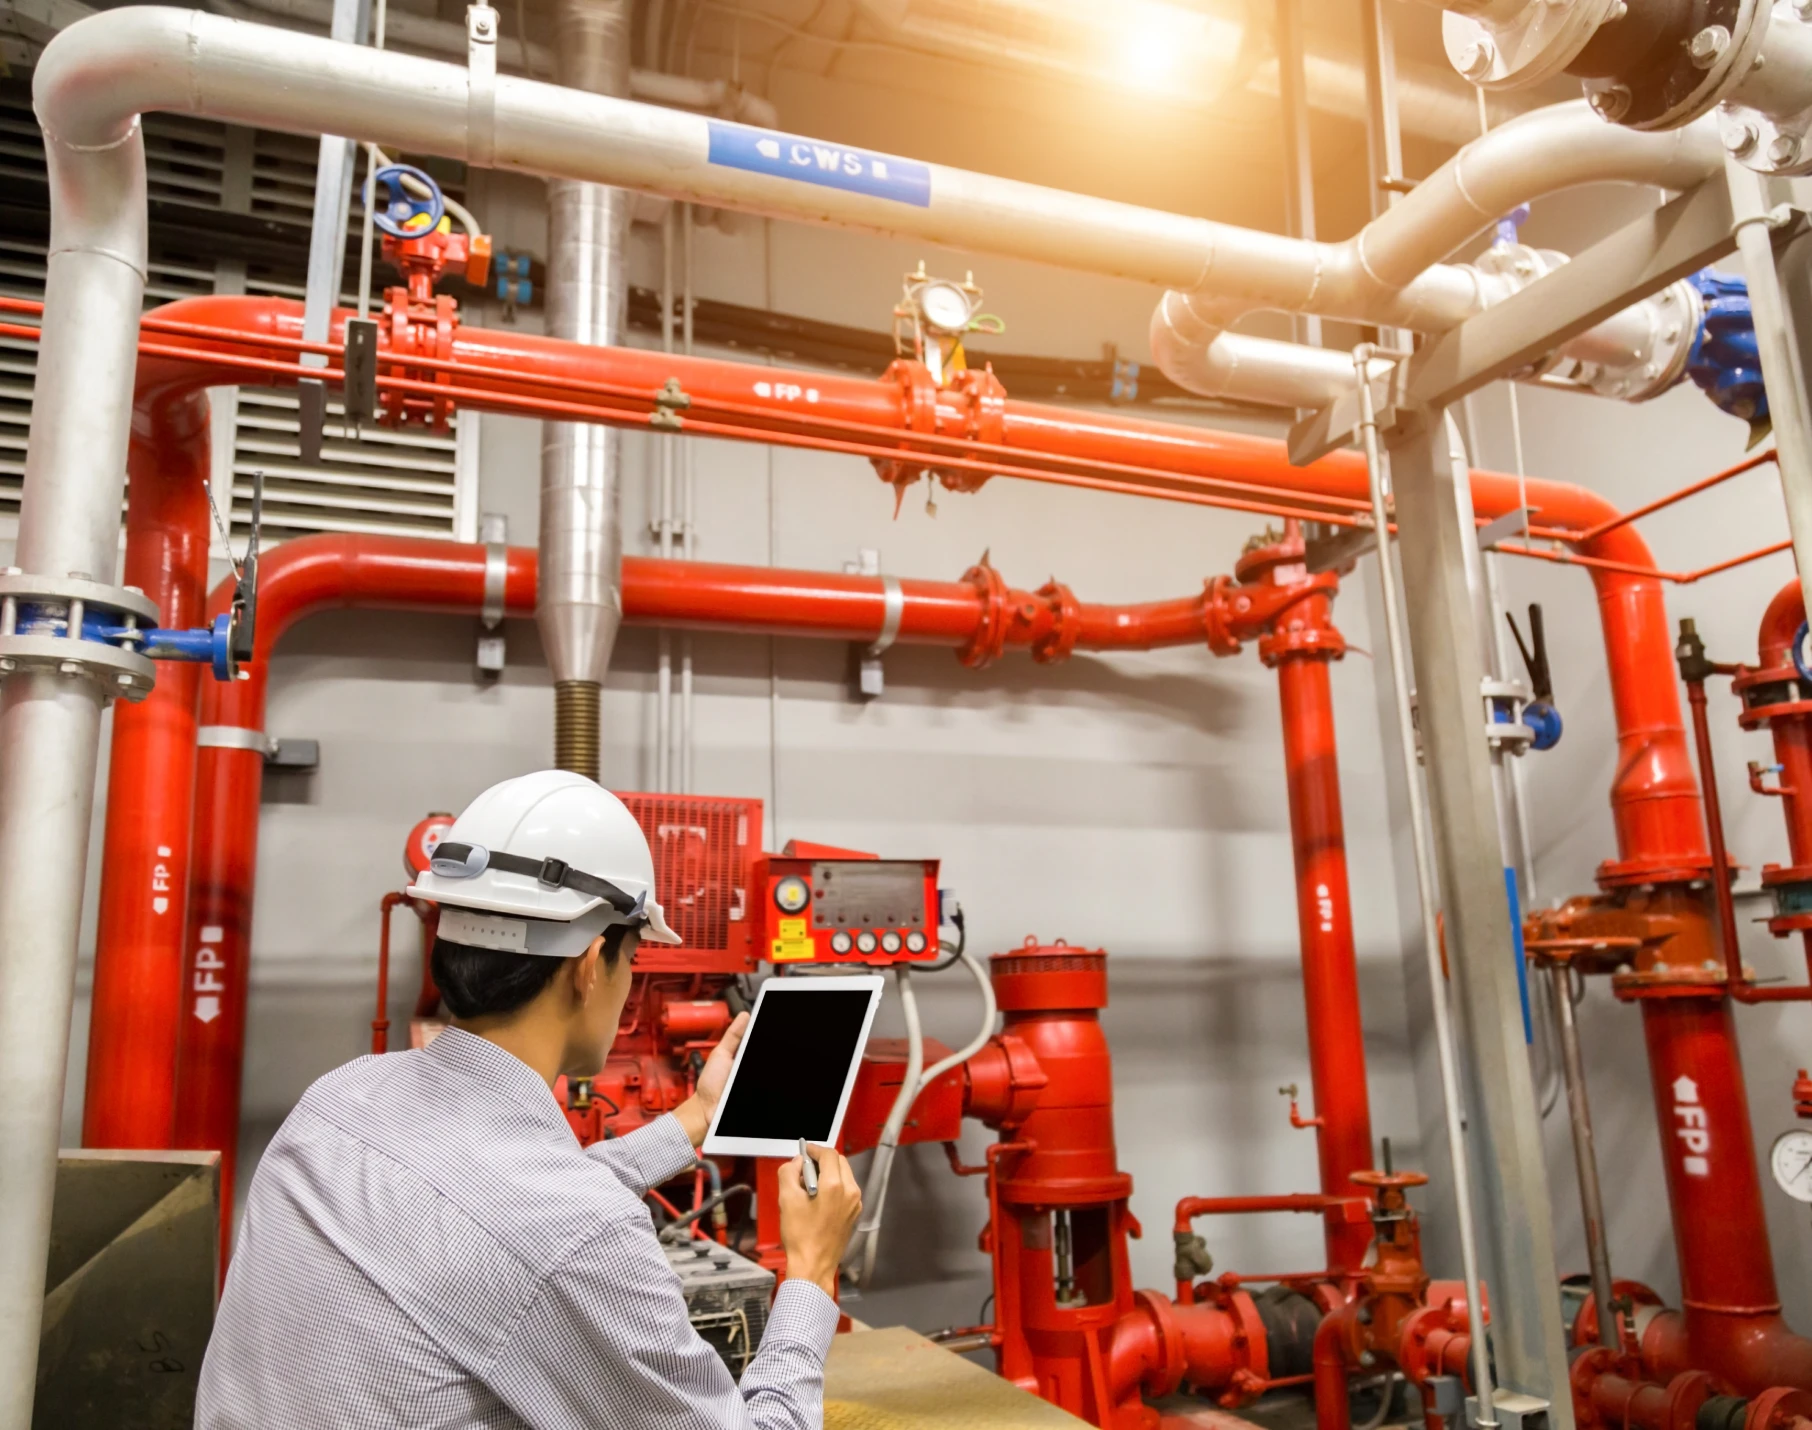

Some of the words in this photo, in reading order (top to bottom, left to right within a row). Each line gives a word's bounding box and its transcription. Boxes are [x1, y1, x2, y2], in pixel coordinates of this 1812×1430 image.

[790, 144, 862, 176] CWS
[774, 383, 802, 401] FP
[152, 864, 171, 891] FP
[193, 948, 225, 992] FP
[1673, 1106, 1710, 1153] FP
